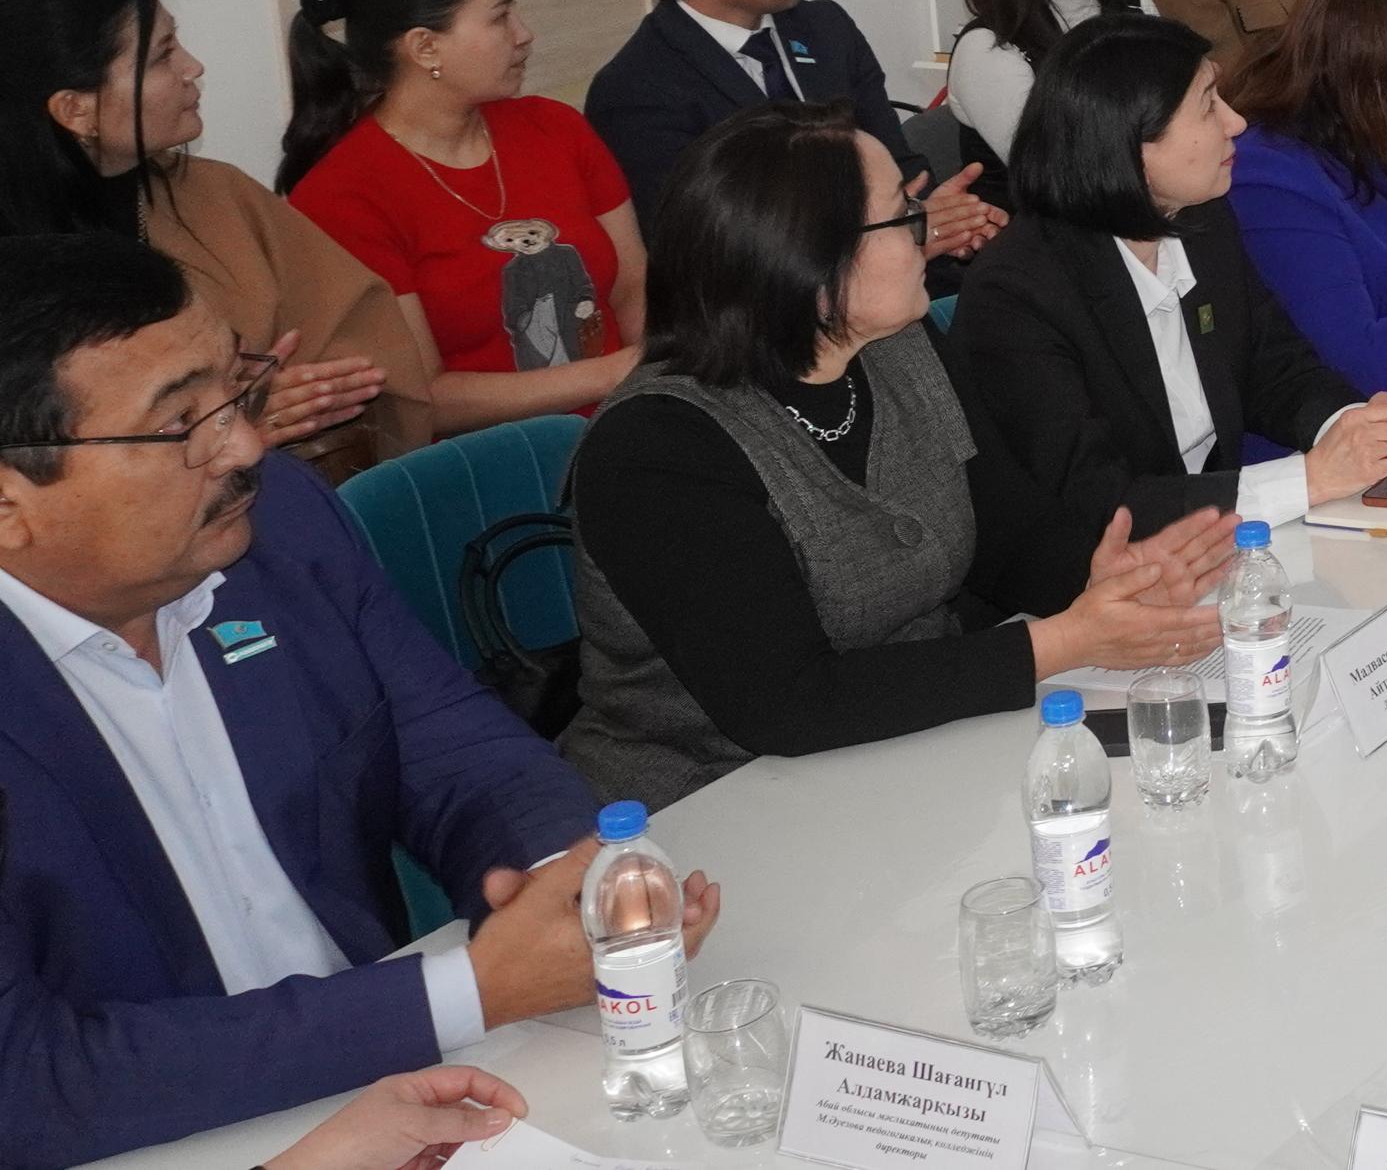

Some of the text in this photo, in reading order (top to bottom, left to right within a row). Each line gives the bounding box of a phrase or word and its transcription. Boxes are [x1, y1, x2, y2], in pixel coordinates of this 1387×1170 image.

[1073, 850, 1111, 878] ALA
[824, 1040, 1008, 1098] Жанаева Шағангүл
[816, 1098, 840, 1111] Абай
[841, 1105, 876, 1119] облысы
[950, 1126, 1000, 1145] депутаты
[875, 1142, 928, 1160] директоры
